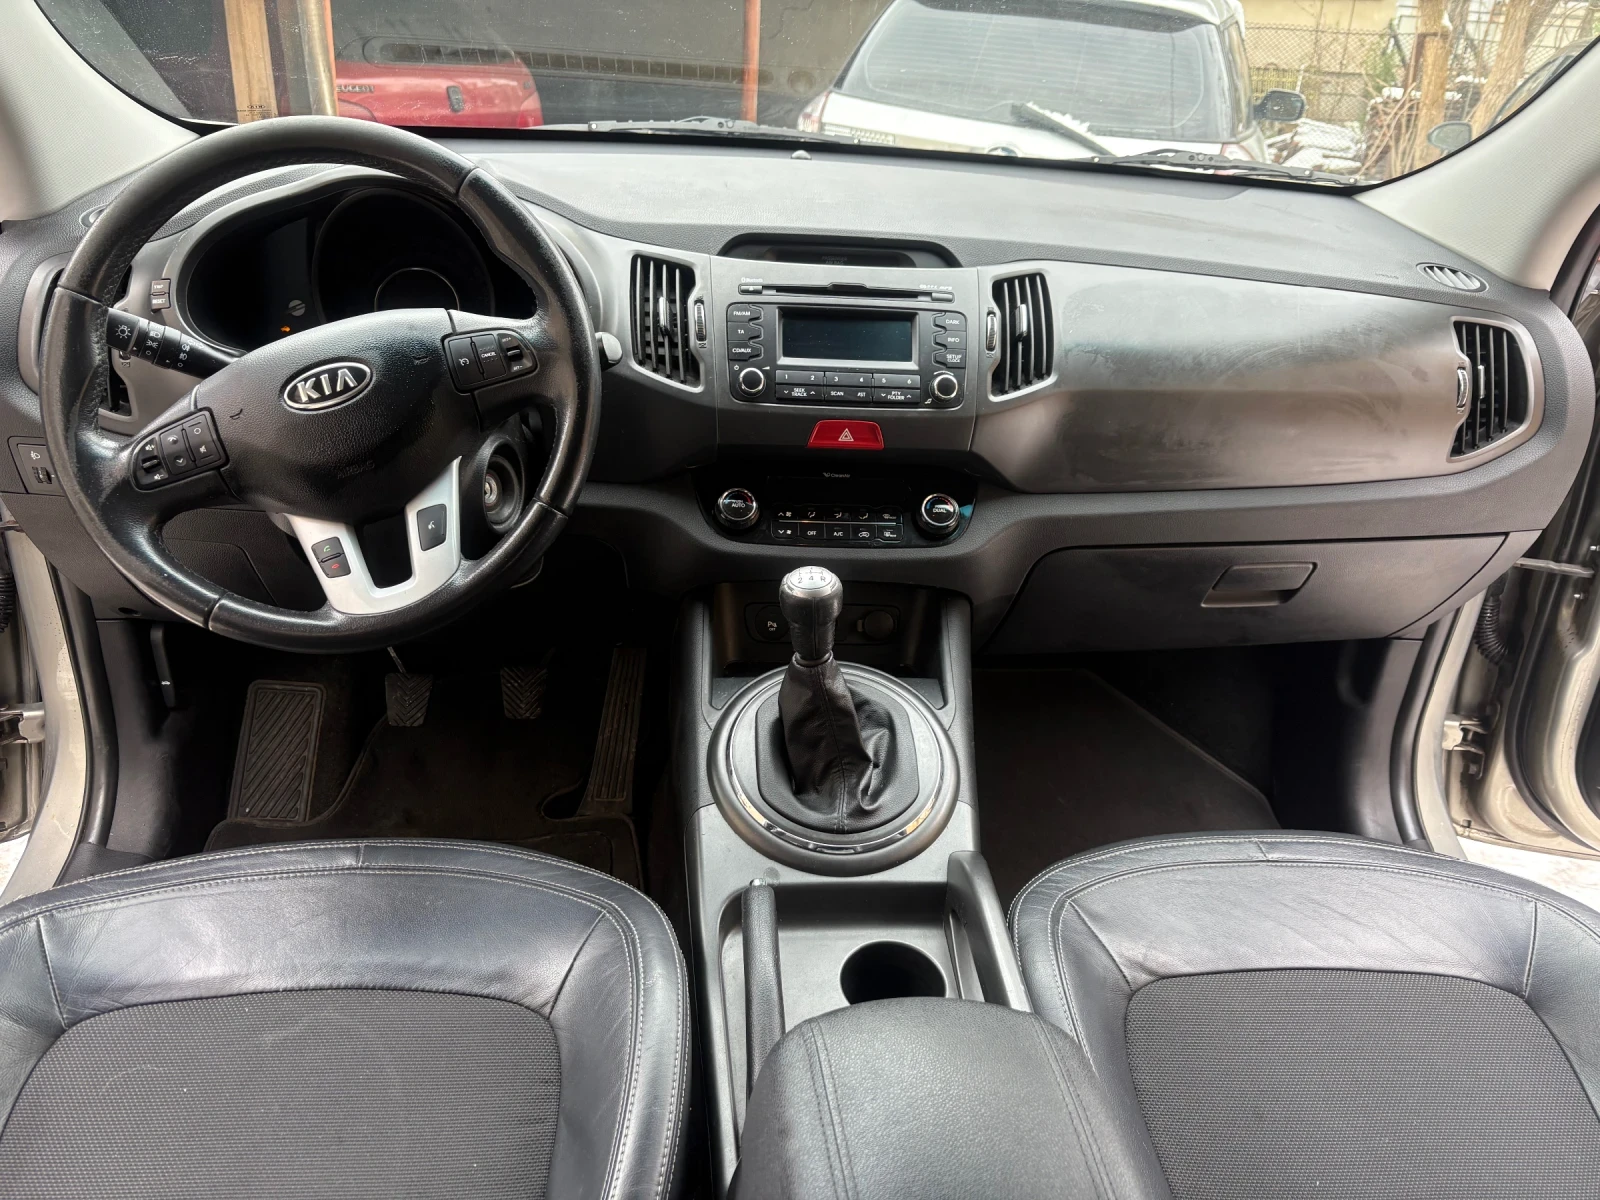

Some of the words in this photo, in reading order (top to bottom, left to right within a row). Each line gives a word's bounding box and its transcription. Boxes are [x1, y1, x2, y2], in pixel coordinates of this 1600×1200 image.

[336, 84, 375, 93] EUGEOT
[481, 351, 497, 359] CANCEL
[296, 368, 358, 403] KIA
